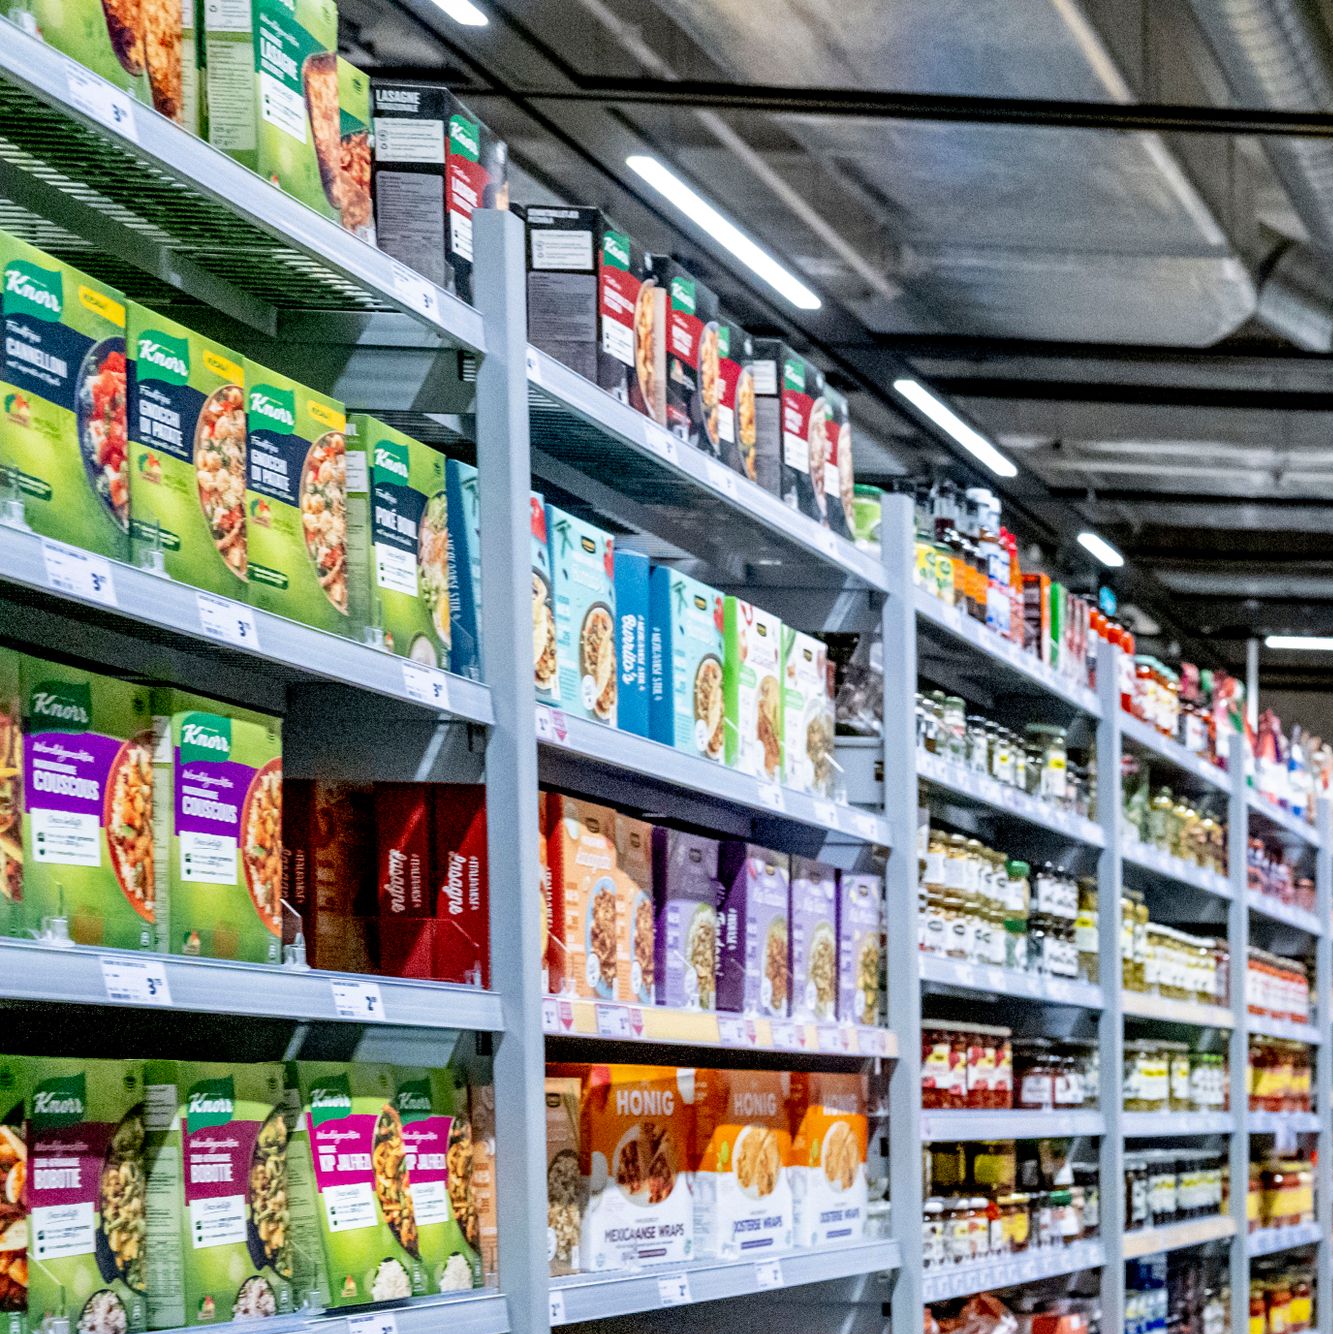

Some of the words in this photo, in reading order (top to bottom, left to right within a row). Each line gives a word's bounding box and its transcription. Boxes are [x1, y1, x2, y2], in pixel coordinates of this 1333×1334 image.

[376, 89, 421, 106] LASAGNE
[5, 269, 62, 314] Knorr
[138, 339, 188, 378] Knorr
[250, 391, 294, 427] Knorr
[375, 447, 409, 480] Knorr
[33, 692, 88, 724] Knorr
[182, 723, 231, 752] Knorr
[33, 769, 99, 801] COUSCOUS
[182, 796, 239, 824] COUSCOUS
[441, 851, 467, 915] Lasagne
[33, 1091, 84, 1114] Knorr
[189, 1091, 233, 1114] Knorr
[311, 1089, 351, 1108] Knorr
[616, 1090, 674, 1117] HONIG
[733, 1093, 777, 1117] HONIG
[658, 1222, 685, 1239] WRAPS
